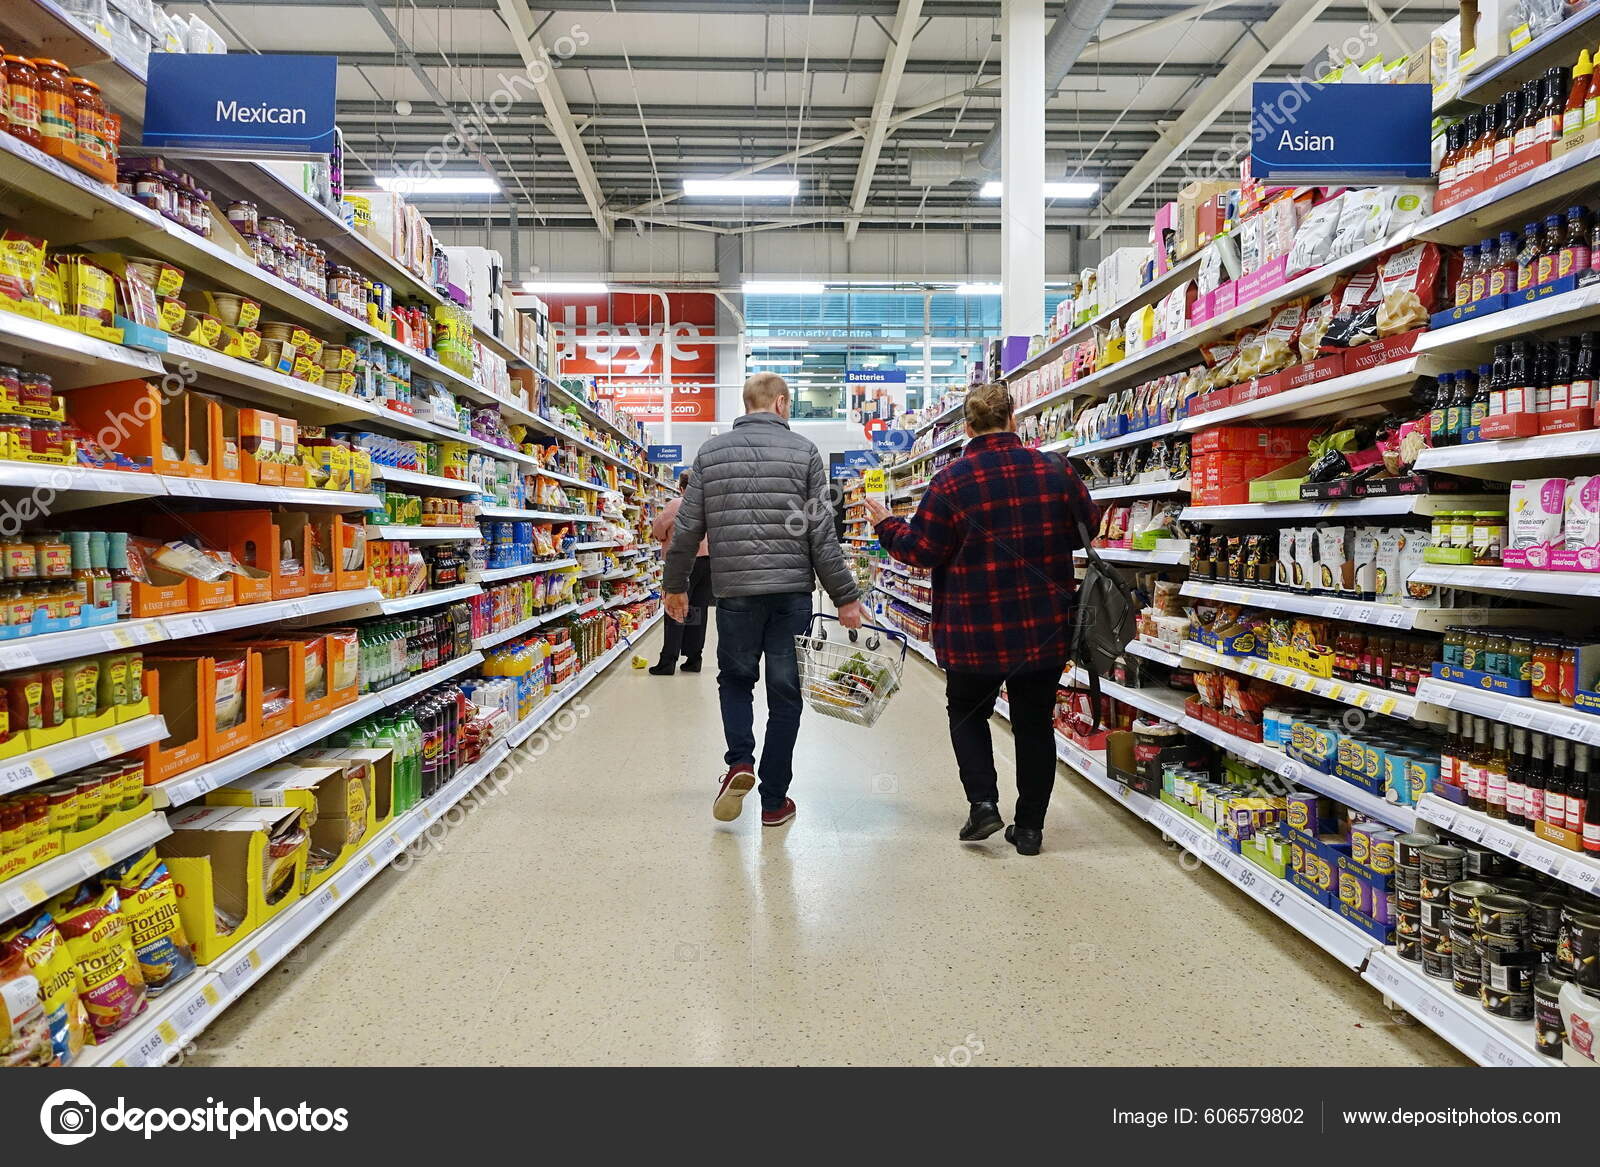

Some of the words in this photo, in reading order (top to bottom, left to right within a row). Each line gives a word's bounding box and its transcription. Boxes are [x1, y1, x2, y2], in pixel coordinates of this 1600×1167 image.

[216, 100, 306, 125] Mexican
[1278, 130, 1334, 151] Asian
[1565, 134, 1584, 148] TESCO
[1539, 286, 1553, 295] SAUCE
[1362, 354, 1377, 365] TASTE
[1378, 351, 1387, 360] OF
[1388, 345, 1410, 358] CHINA
[849, 373, 884, 382] Batteries
[1316, 368, 1332, 378] CHINA
[632, 380, 672, 394] wit
[679, 380, 700, 394] us
[1543, 491, 1550, 502] 5
[1583, 489, 1590, 500] 5
[1520, 508, 1534, 516] itsu
[1568, 722, 1585, 737] £1
[6, 766, 33, 783] £1.99
[196, 776, 210, 792] £1
[1214, 852, 1230, 871] £1.44
[1238, 870, 1256, 888] 95p
[1579, 872, 1596, 884] 99p
[1270, 890, 1285, 907] £2
[126, 902, 178, 933] Tortilla
[134, 921, 175, 944] STRIPS
[136, 938, 168, 957] ORIGINAL
[88, 980, 118, 999] CHEESE
[187, 996, 206, 1016] £1.65
[140, 1034, 162, 1056] £1.65
